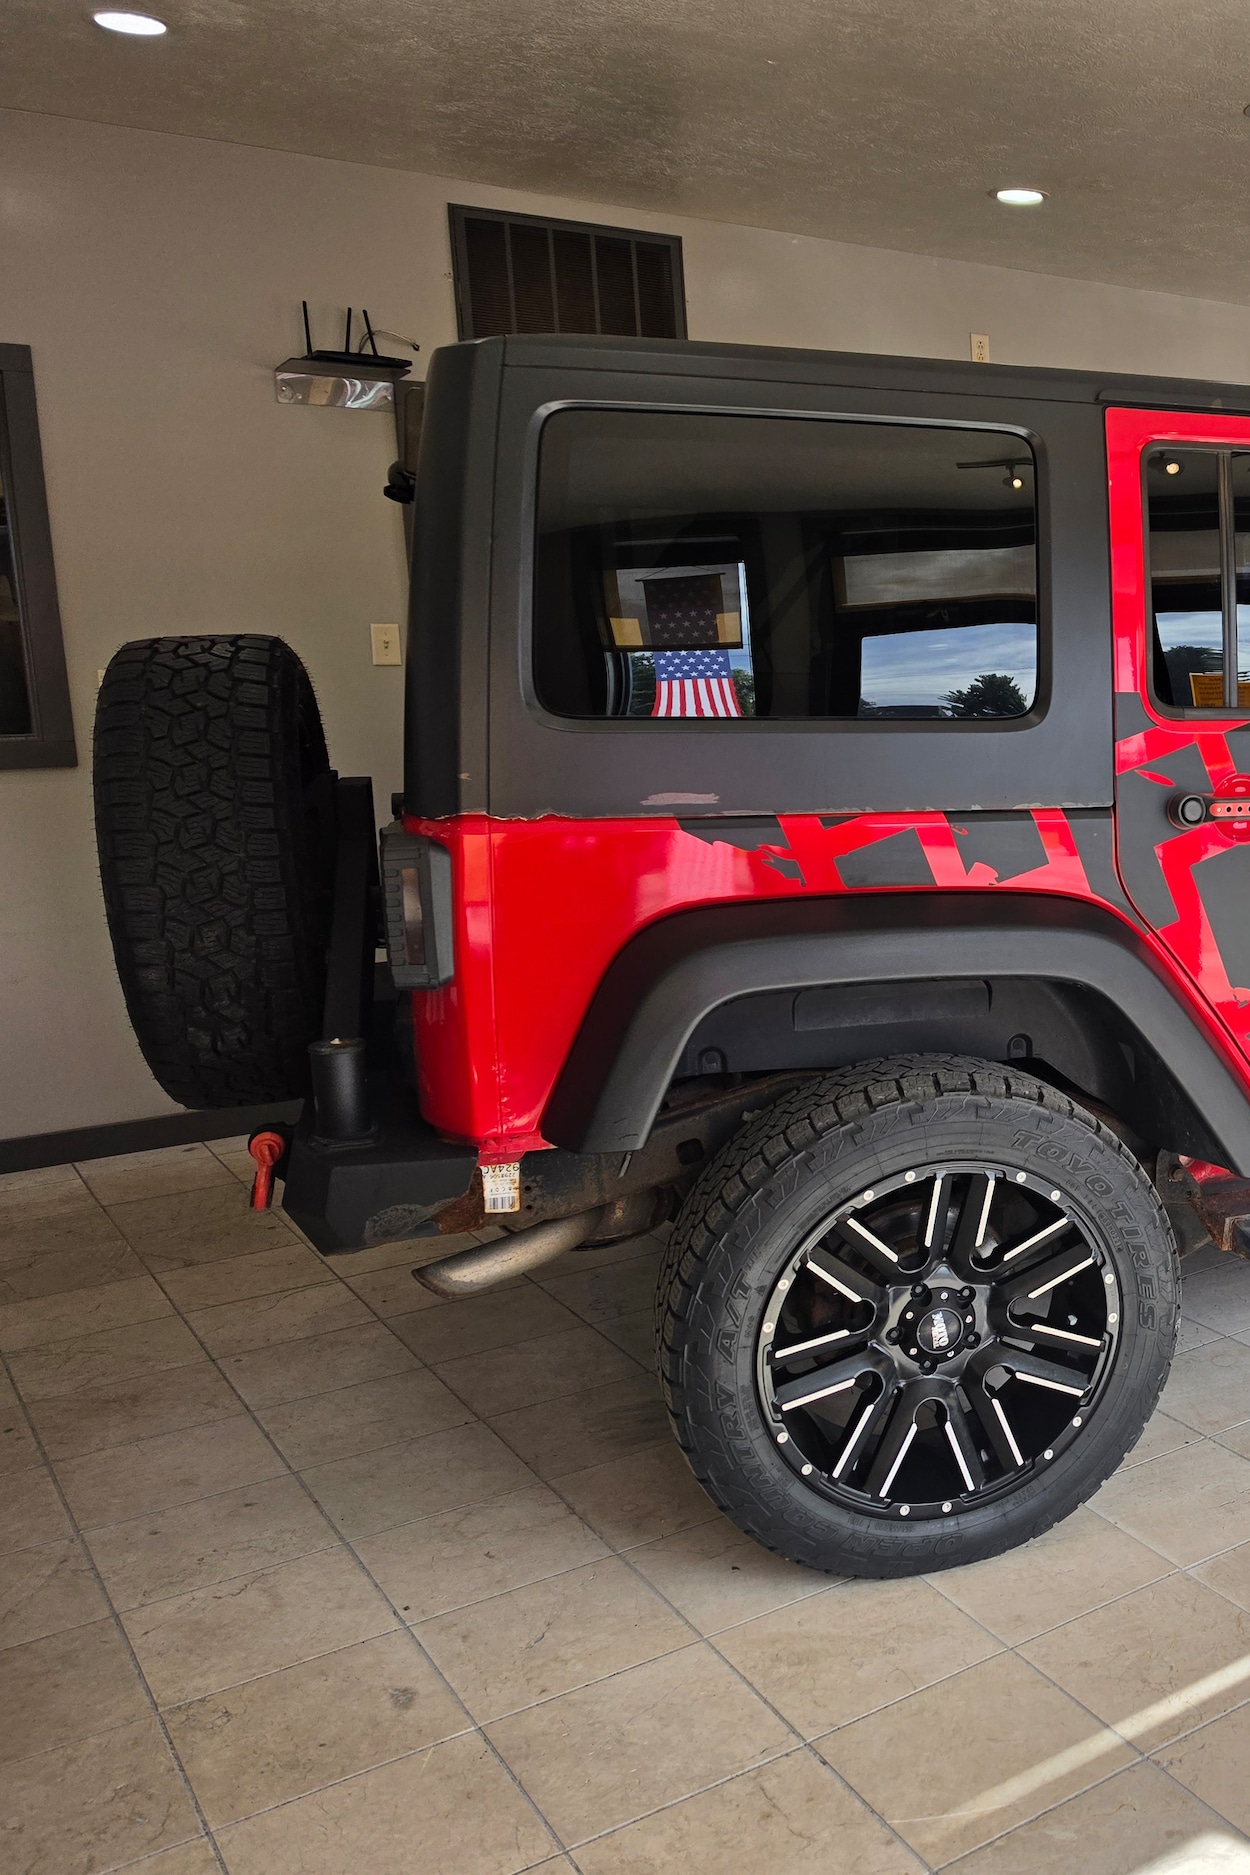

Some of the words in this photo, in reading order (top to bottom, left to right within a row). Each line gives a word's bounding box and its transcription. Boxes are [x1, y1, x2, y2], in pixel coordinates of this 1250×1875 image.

[1011, 1129, 1115, 1198] TOYO
[1111, 1201, 1157, 1331] TIRES
[716, 1267, 752, 1364] A/T
[715, 1380, 839, 1540] COUNTRY
[841, 1532, 966, 1557] OPEN
